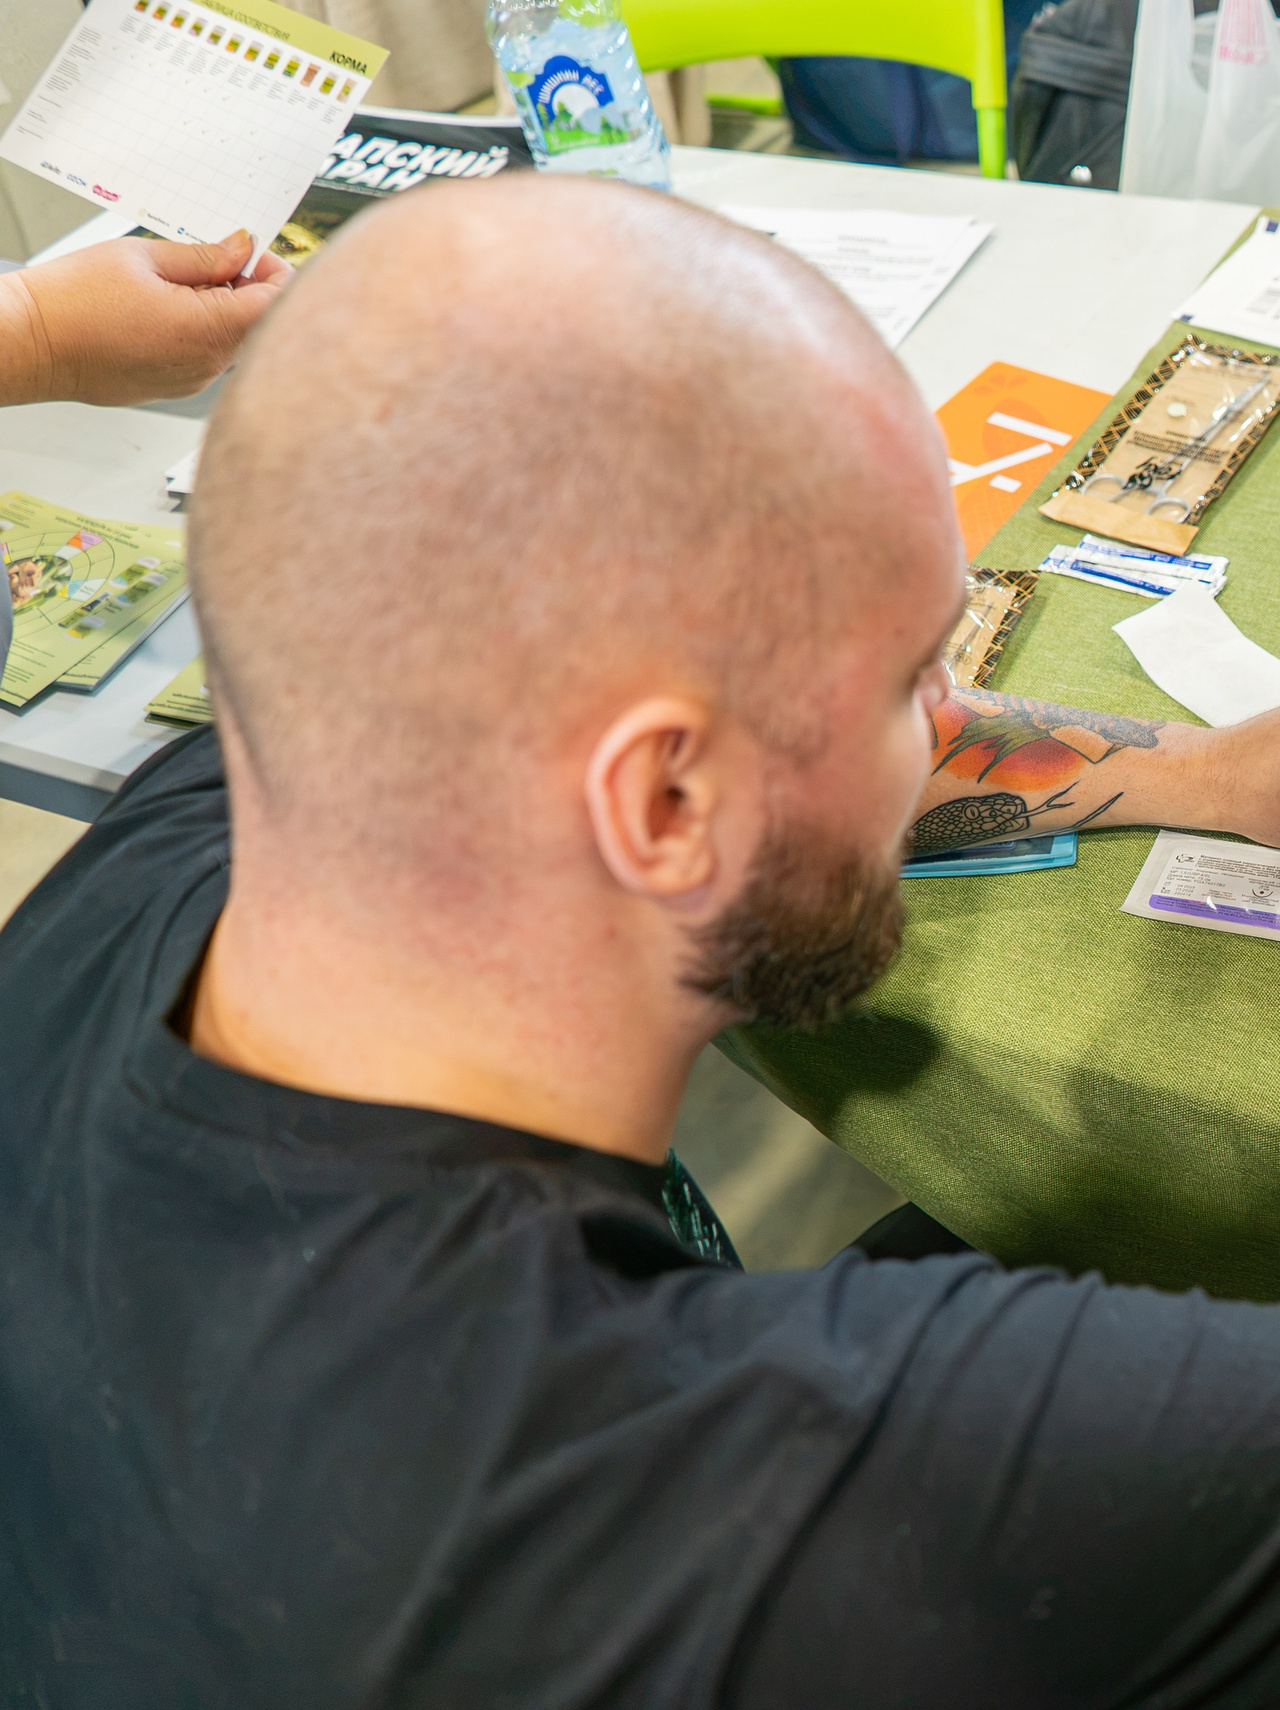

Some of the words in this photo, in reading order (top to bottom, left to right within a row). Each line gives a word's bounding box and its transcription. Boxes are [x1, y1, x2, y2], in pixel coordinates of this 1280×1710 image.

[329, 50, 368, 74] КОРМА
[580, 73, 605, 96] ЛЕС
[331, 132, 510, 179] АПСКИЙ
